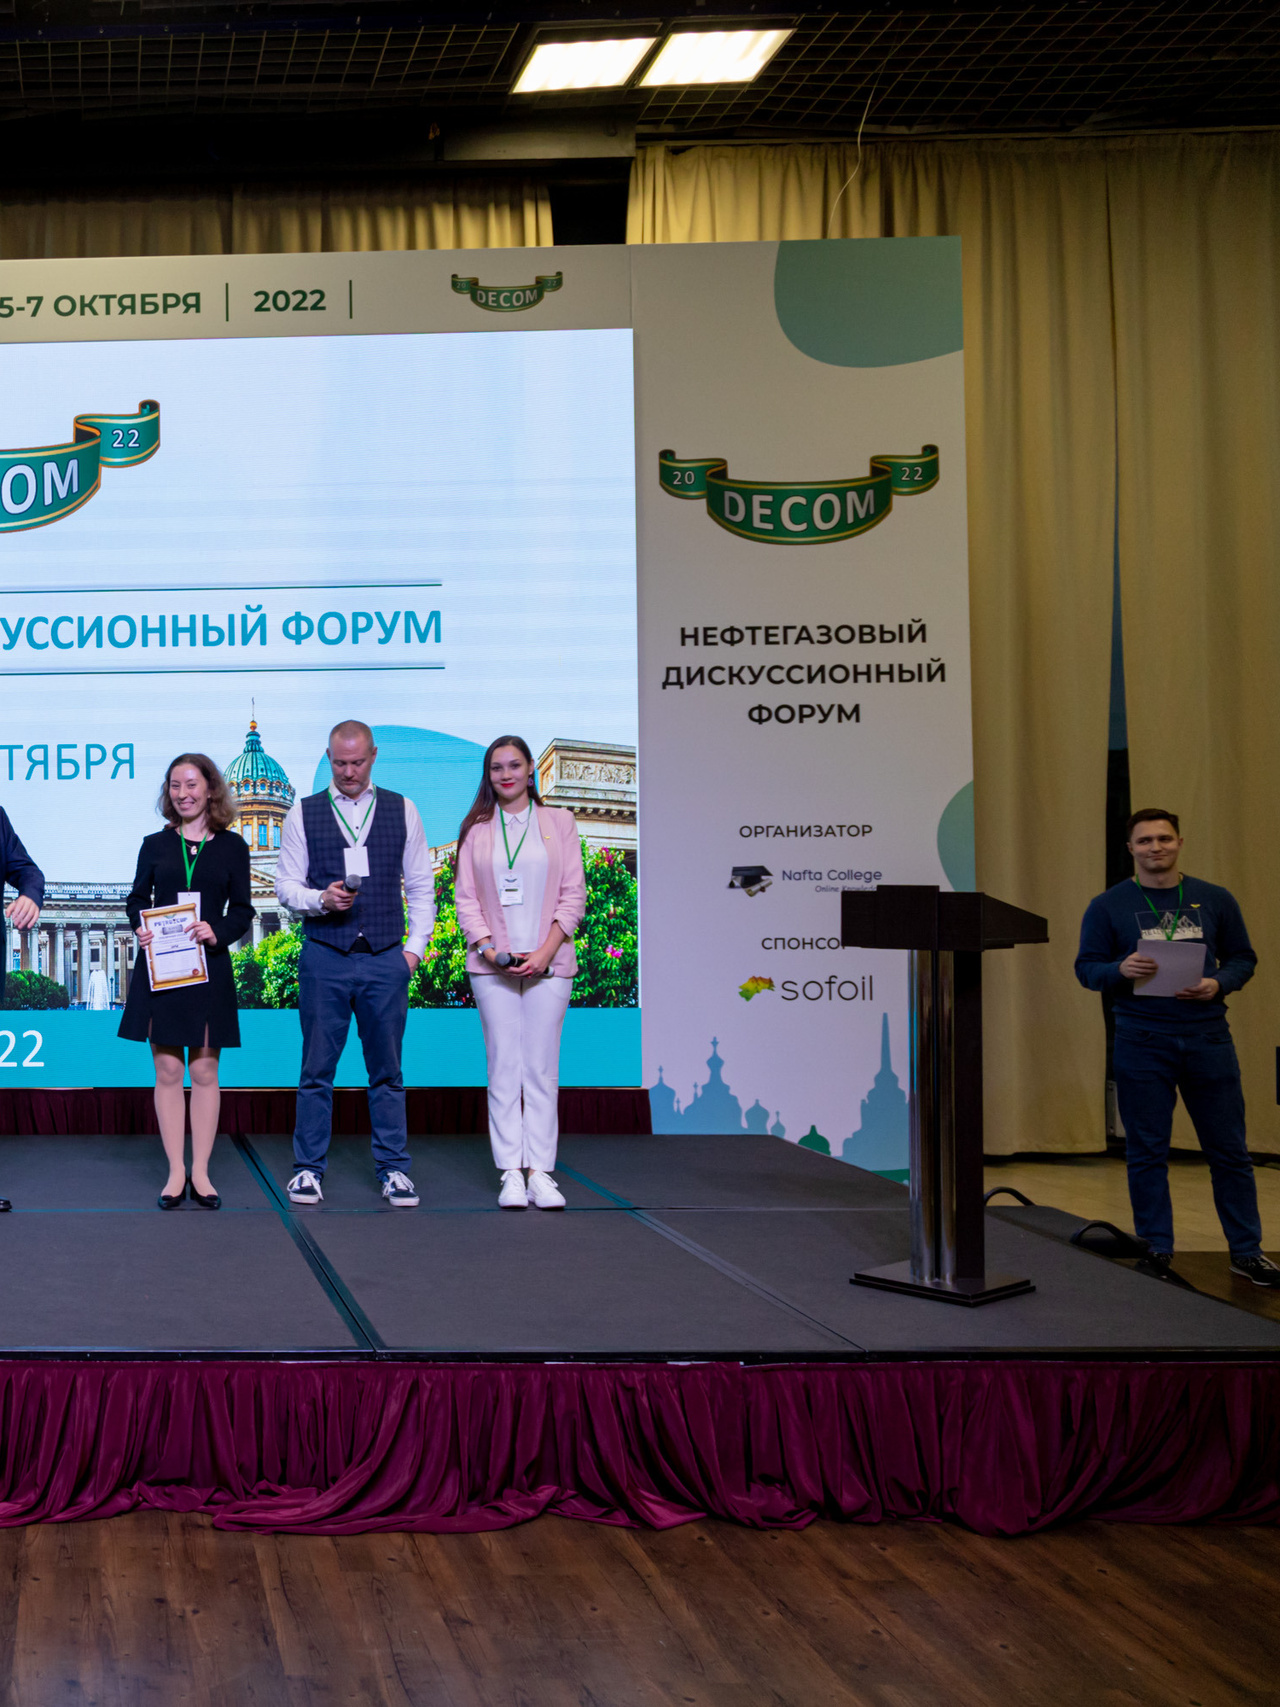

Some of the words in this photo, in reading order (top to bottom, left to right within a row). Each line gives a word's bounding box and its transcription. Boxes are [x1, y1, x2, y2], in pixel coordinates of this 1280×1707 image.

[53, 291, 202, 318] ОКТЯБРЯ
[253, 288, 327, 313] 2022
[476, 289, 538, 307] DECOM
[111, 428, 140, 448] 22
[672, 471, 695, 485] 20
[723, 488, 875, 532] DECOM
[900, 466, 923, 481] 22
[281, 610, 442, 648] ФОРУМ
[680, 617, 927, 647] НЕФТЕГАЗОВЫЙ
[661, 657, 947, 691] ДИСКУССИОННЫЙ
[747, 703, 861, 726] ФОРУМ
[738, 824, 873, 839] ОРГАНИЗАТОР
[781, 869, 823, 881] Nafta
[826, 869, 883, 884] College
[814, 885, 839, 893] Online
[760, 936, 845, 951] СПОНСО
[780, 974, 874, 1002] sofoil
